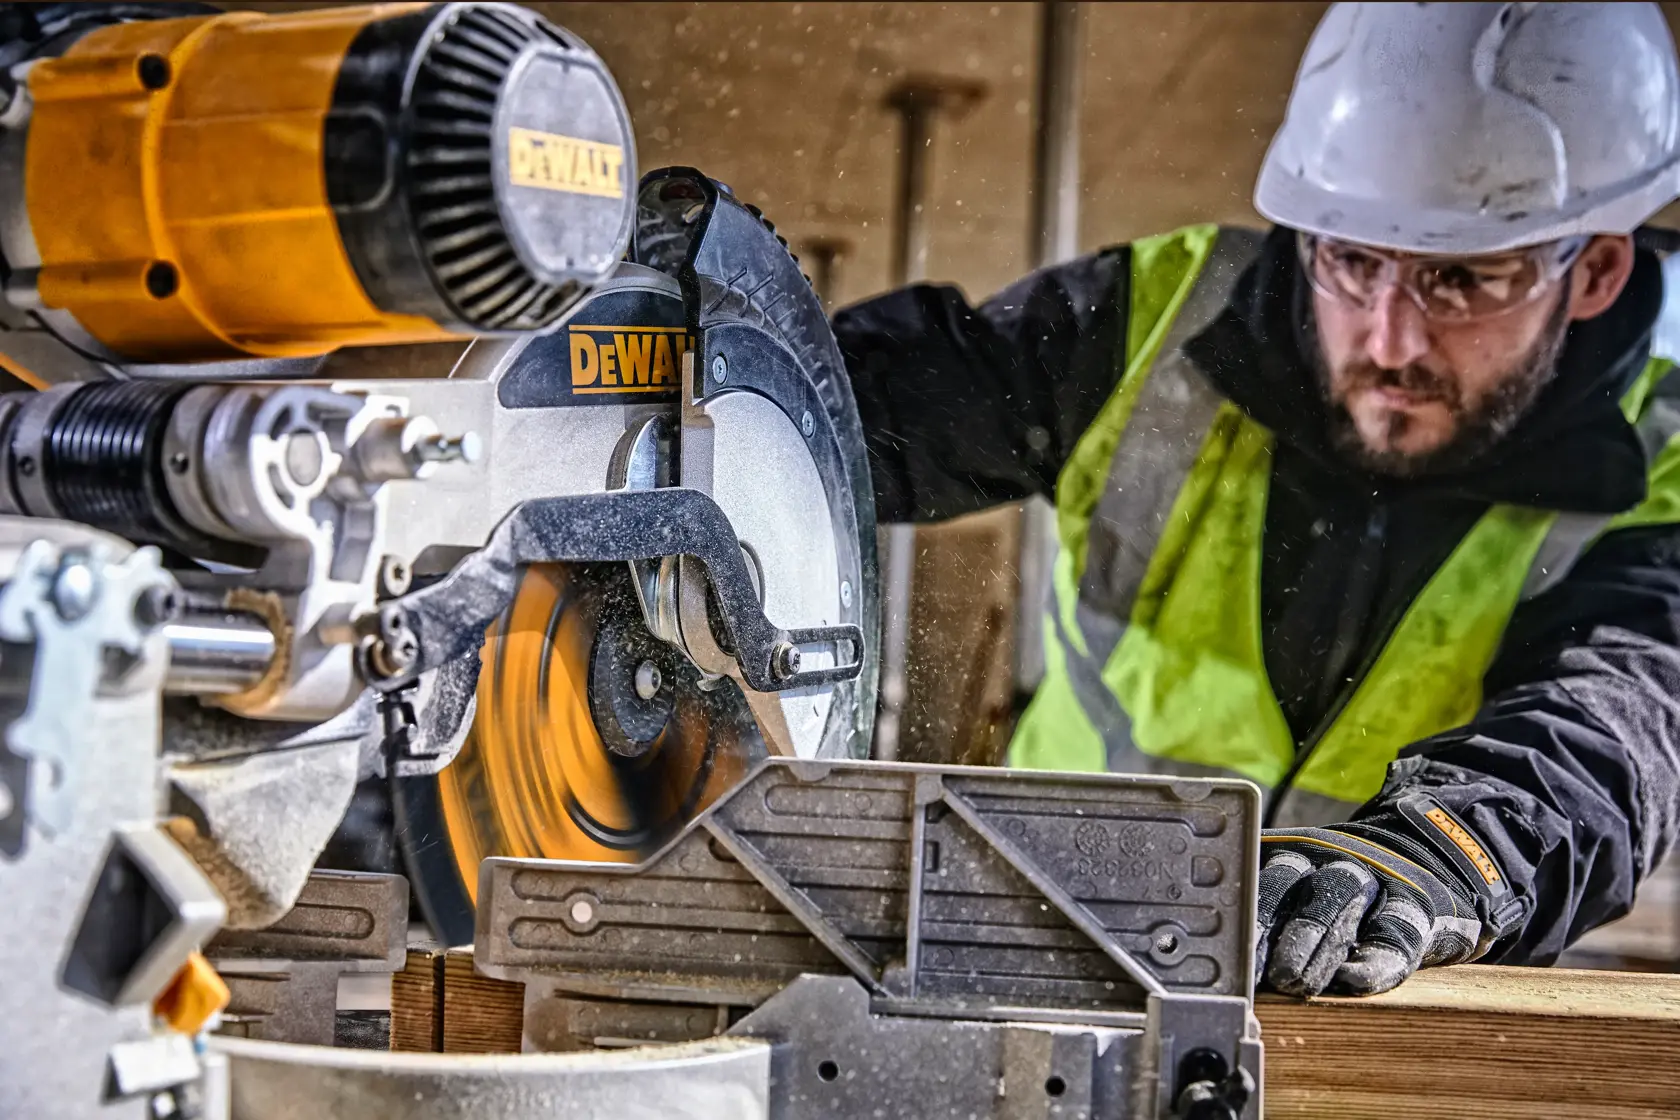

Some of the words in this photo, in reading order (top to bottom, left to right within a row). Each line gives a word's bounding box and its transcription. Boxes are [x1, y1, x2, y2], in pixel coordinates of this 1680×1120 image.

[510, 131, 622, 192] DEWALT
[569, 333, 695, 386] DEWA
[1427, 810, 1498, 882] DEWALT
